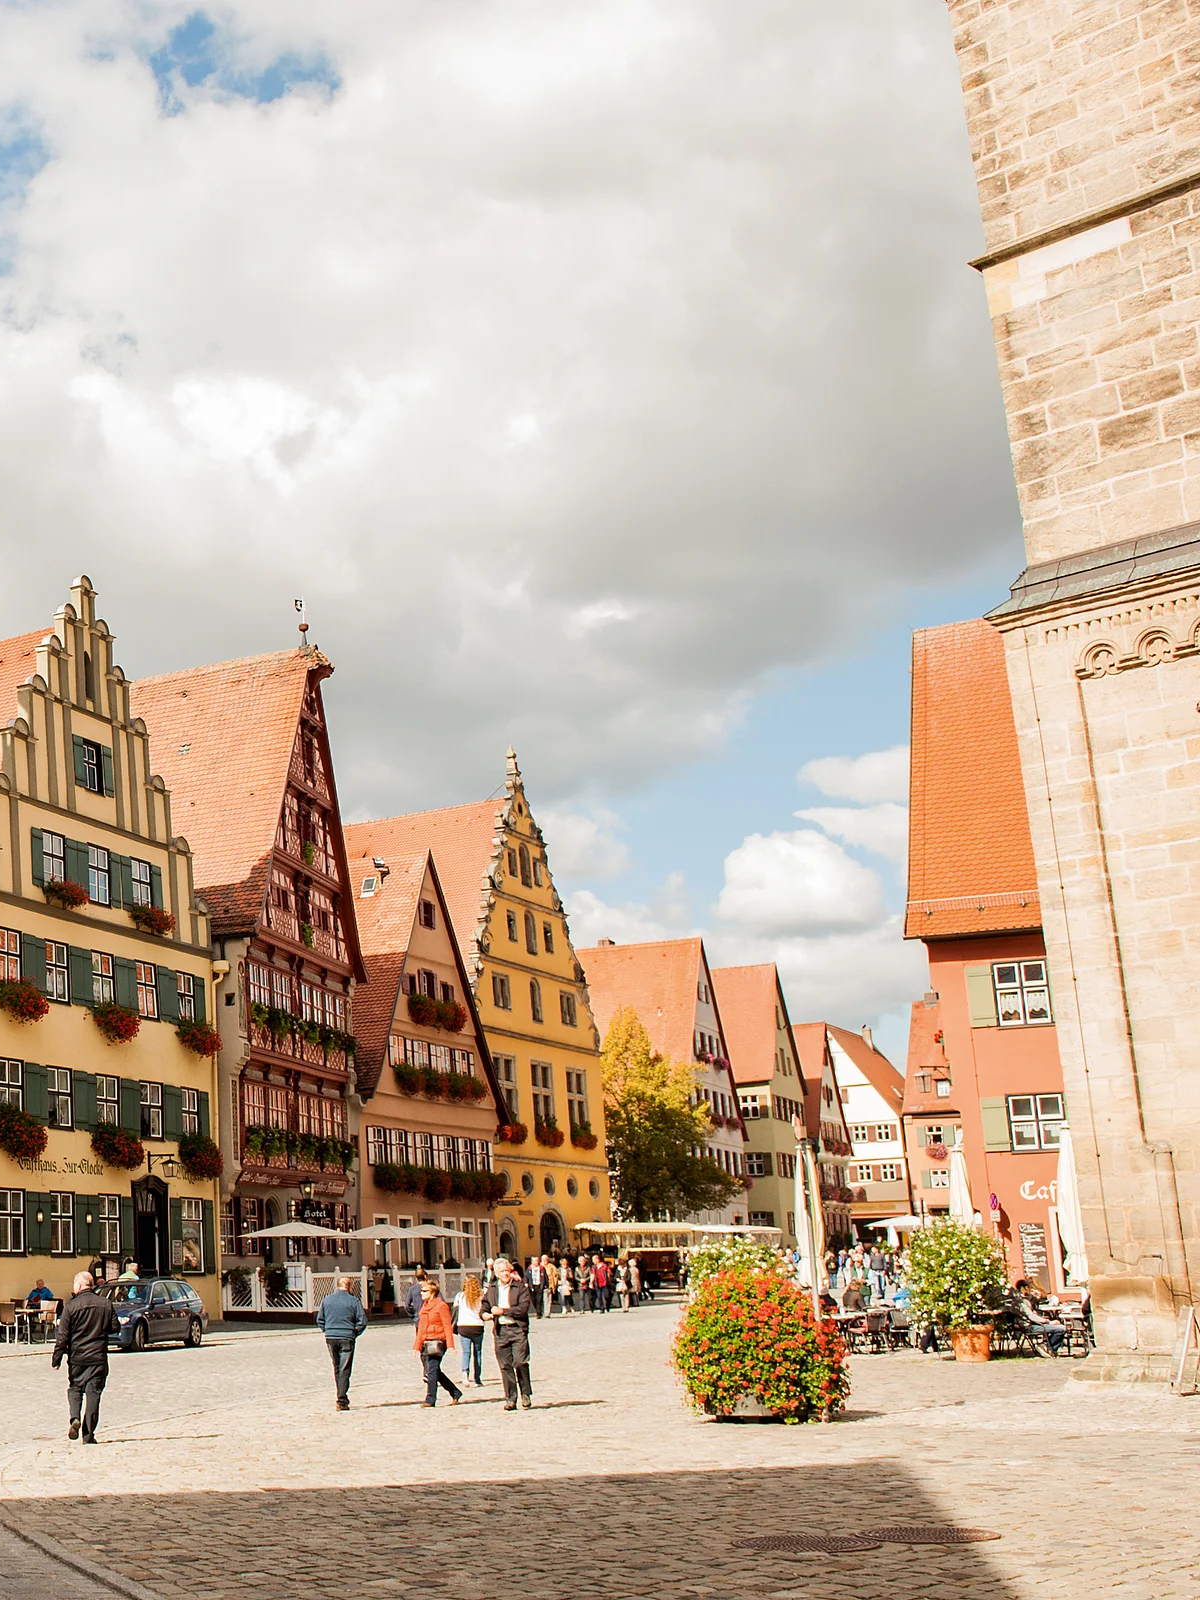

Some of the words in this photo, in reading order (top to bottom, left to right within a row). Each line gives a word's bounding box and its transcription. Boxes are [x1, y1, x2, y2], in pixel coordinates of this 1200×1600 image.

[17, 1156, 58, 1175] Gasthaus
[1019, 1180, 1058, 1203] Caf
[303, 1209, 327, 1218] Hotel
